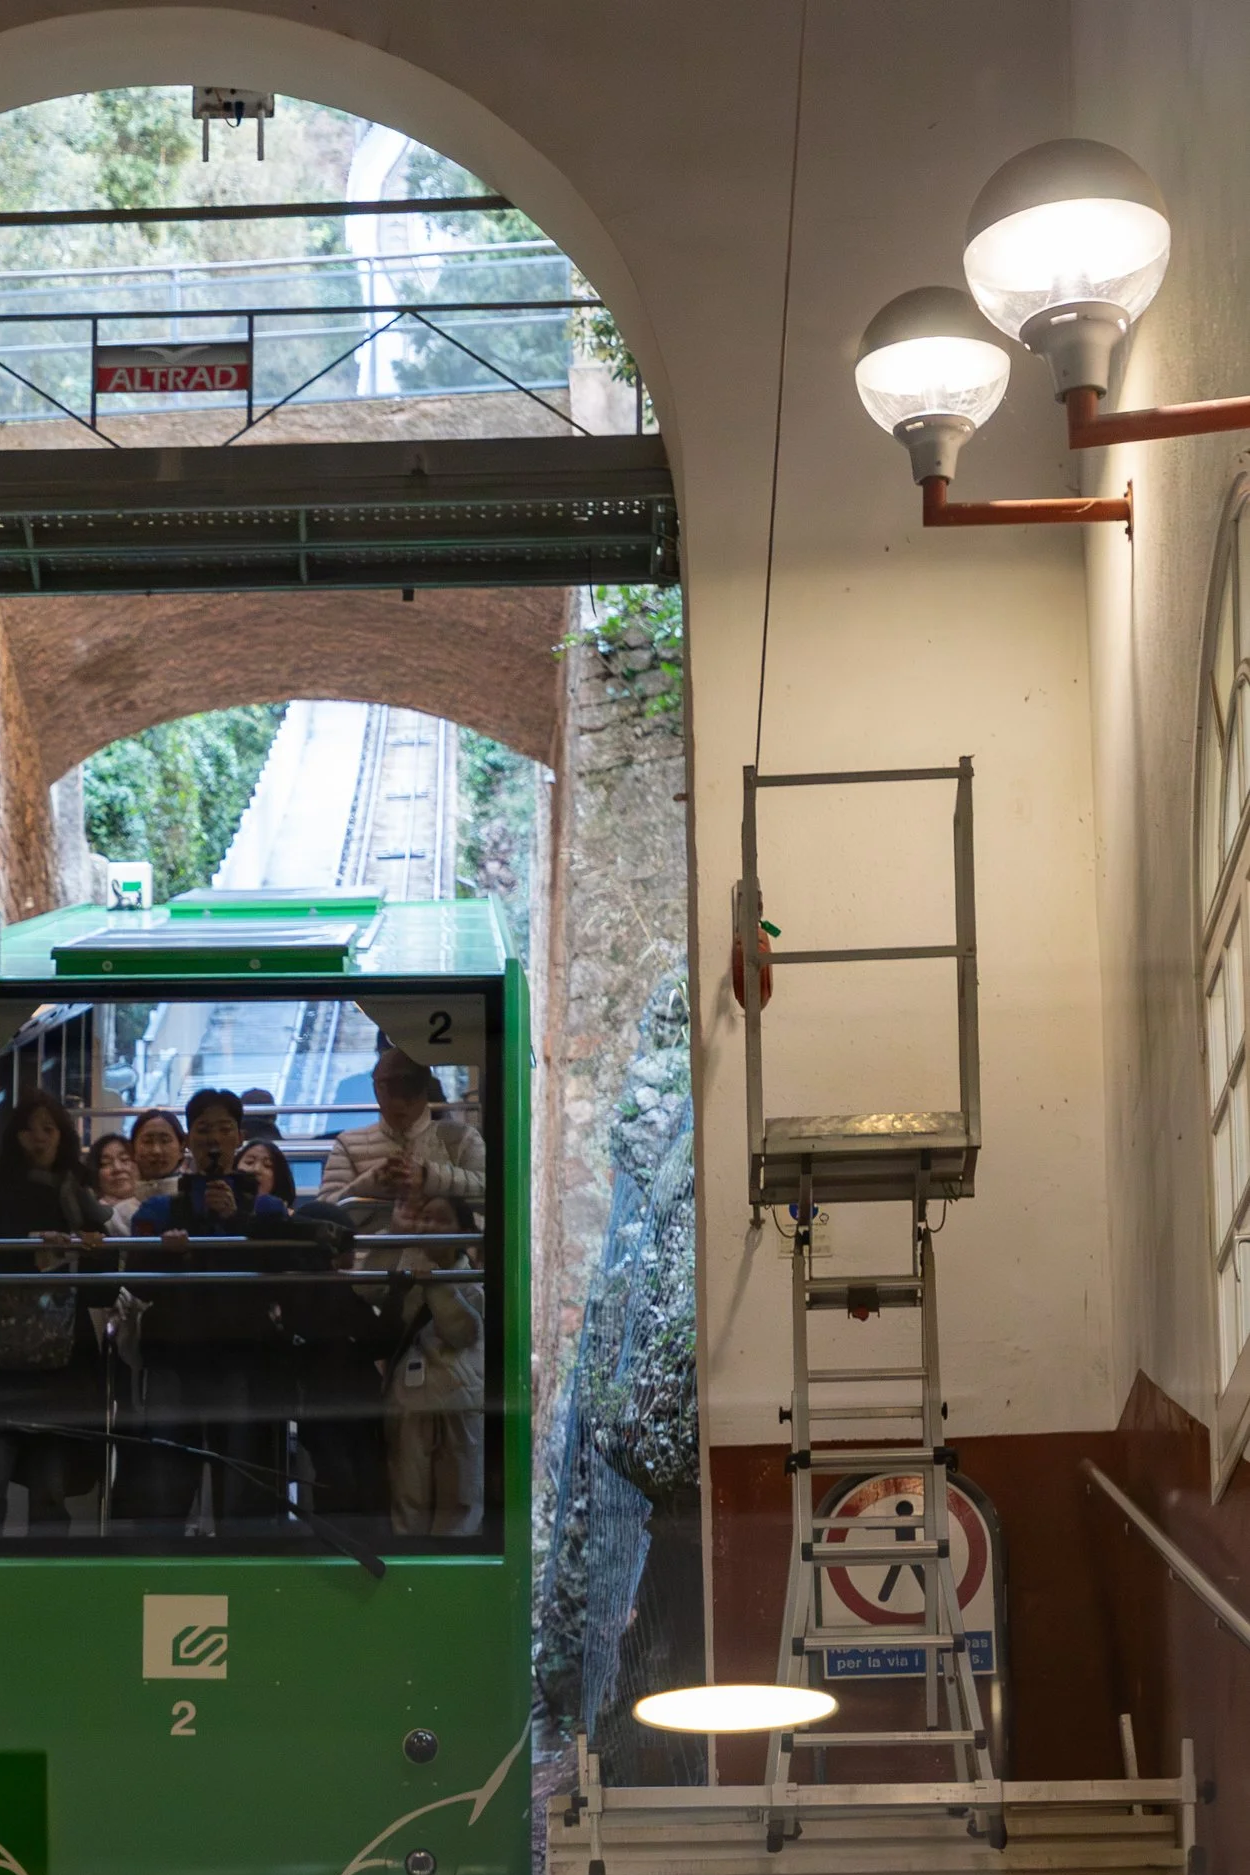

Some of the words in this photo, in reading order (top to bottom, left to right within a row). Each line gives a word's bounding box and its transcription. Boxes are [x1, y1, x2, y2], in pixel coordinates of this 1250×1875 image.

[107, 366, 239, 391] ALTRAD
[428, 1010, 452, 1044] 2
[837, 1658, 862, 1672] per
[867, 1656, 881, 1668] la
[170, 1700, 197, 1736] 2
